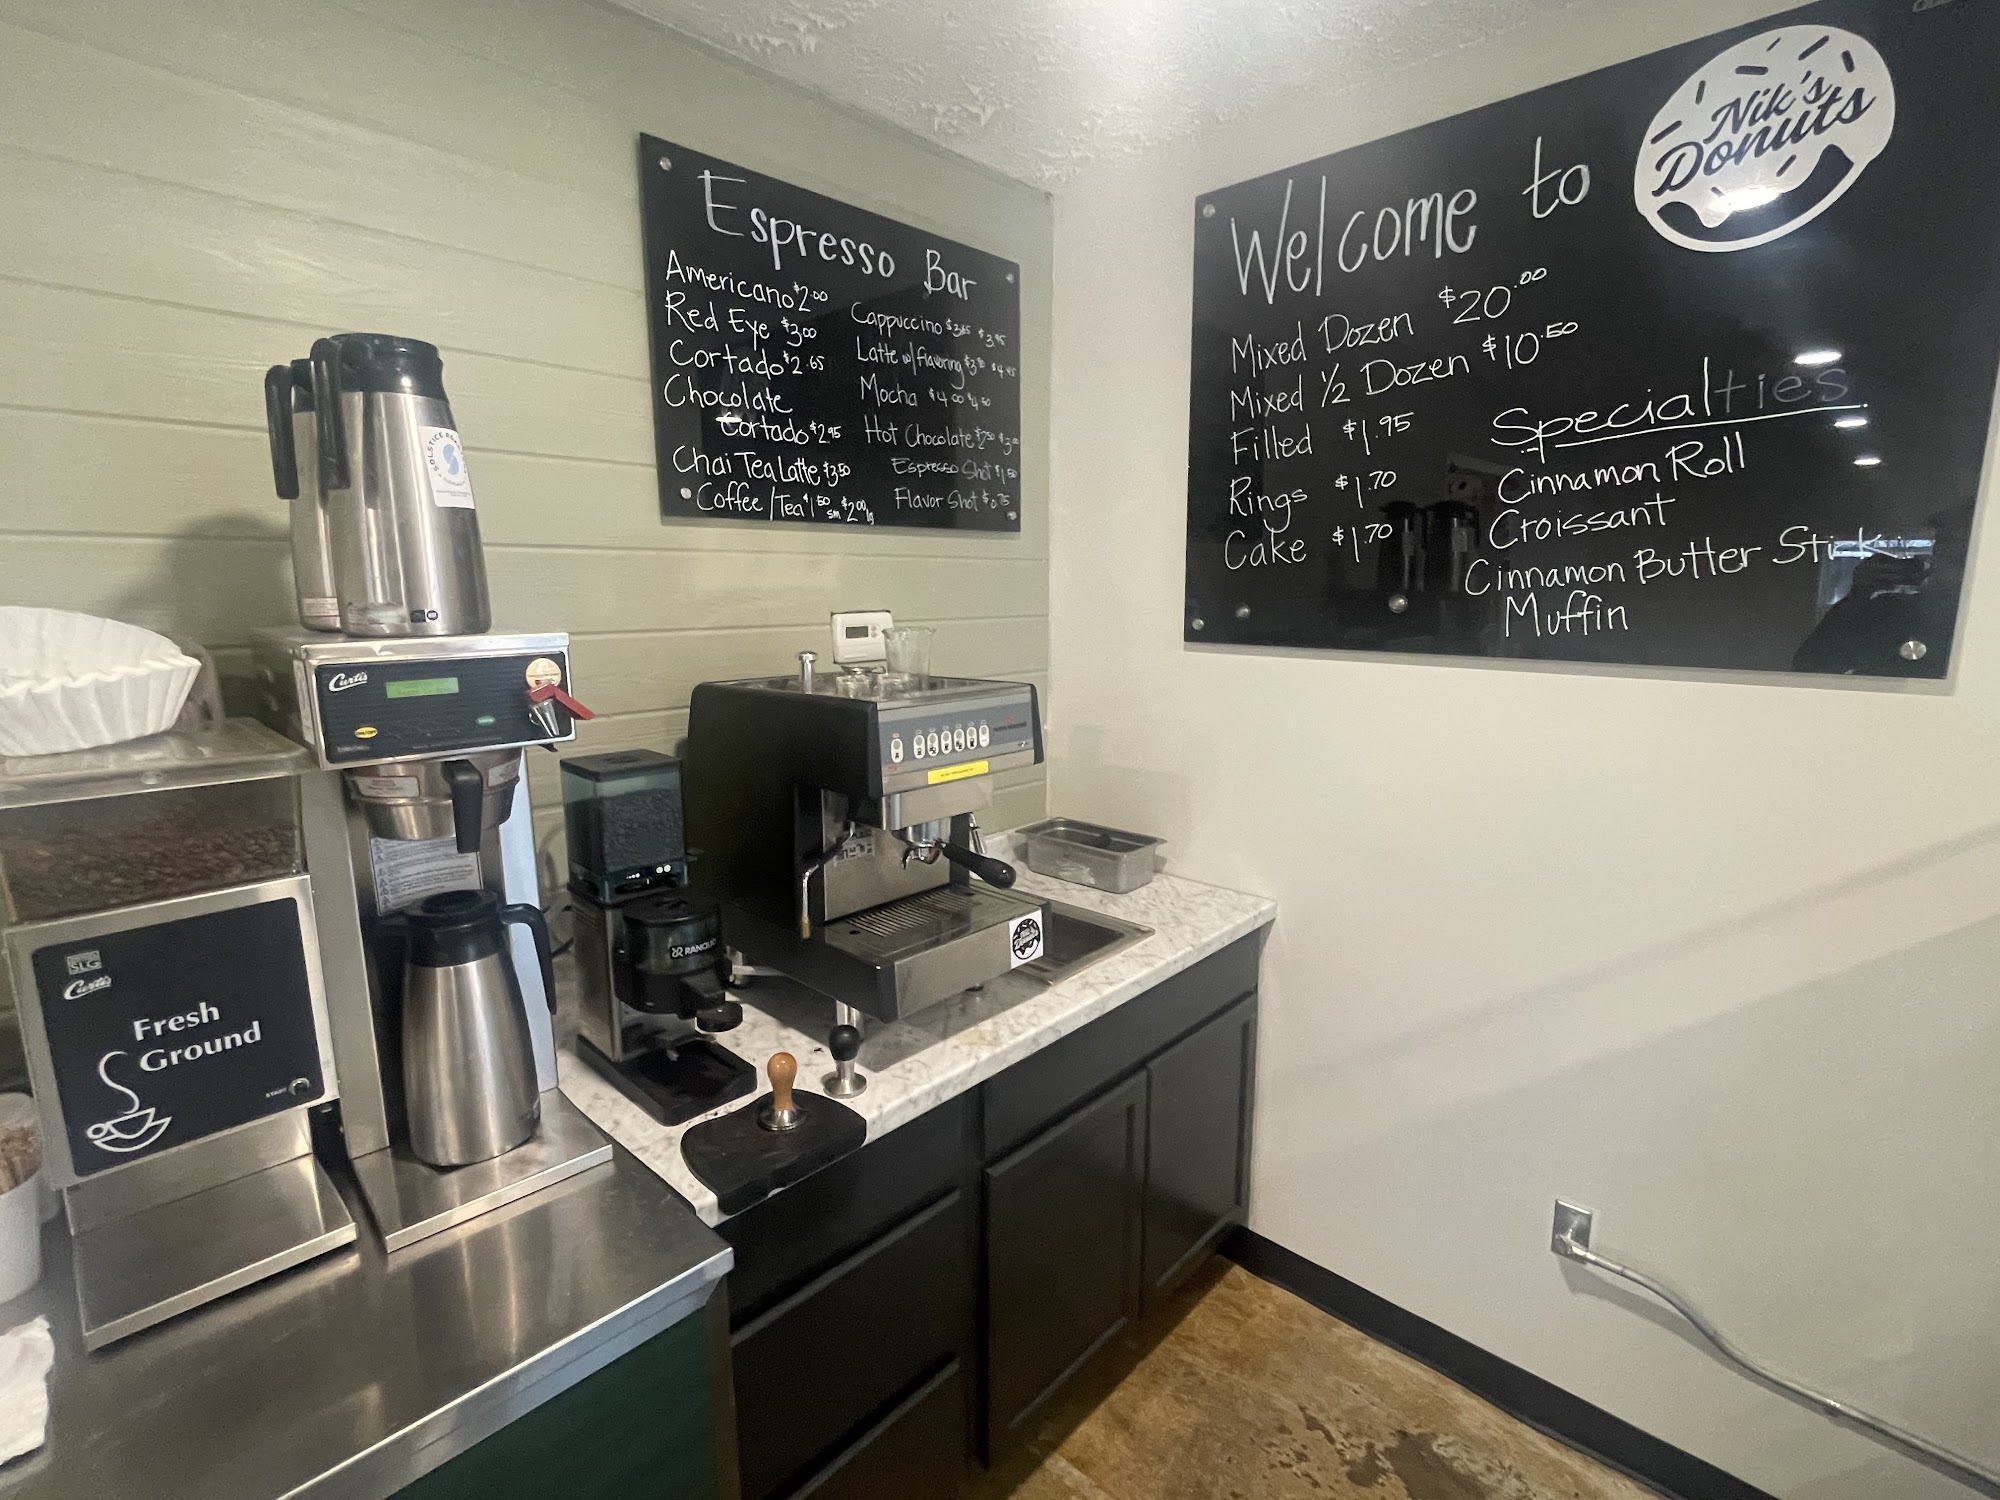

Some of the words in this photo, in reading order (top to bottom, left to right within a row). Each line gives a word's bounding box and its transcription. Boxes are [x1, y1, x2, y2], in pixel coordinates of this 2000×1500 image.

[1703, 70, 1835, 145] Nik's
[1651, 86, 1878, 198] Donuts
[697, 169, 896, 278] Espresso
[923, 248, 978, 301] Bar
[1230, 175, 1477, 305] Welcome
[1521, 136, 1591, 219] to
[665, 249, 795, 309] Americano
[793, 281, 829, 313] $2.00
[665, 289, 720, 333] Red
[728, 308, 770, 351] Eye
[851, 301, 943, 338] Cappuccino
[1231, 321, 1307, 378] Mixed
[1317, 311, 1414, 354] Dozen
[1438, 267, 1547, 324] $20.00
[669, 339, 785, 380] Cortado
[783, 350, 825, 375] $2.65
[856, 335, 898, 364] Latte
[1230, 374, 1303, 421] Mixed
[1360, 353, 1470, 396] Dozen
[1481, 321, 1579, 369] $10.50
[664, 373, 793, 414] Chocolate
[860, 372, 918, 407] Mocha
[1490, 356, 1849, 464] Specialties
[427, 431, 444, 472] SOLSTICE
[720, 411, 810, 445] Cortado
[809, 420, 842, 444] $2.95
[864, 414, 898, 446] Hot
[904, 423, 975, 449] Chocolate
[1230, 423, 1313, 465] Filled
[1342, 411, 1415, 455] $1.95
[672, 445, 732, 476] Chai
[734, 451, 778, 482] Tea
[778, 455, 821, 486] Latte
[890, 457, 960, 478] Espresso
[961, 459, 992, 480] Shot
[1497, 460, 1657, 504] Cinnamon
[1665, 431, 1744, 482] Roll
[696, 481, 764, 512] Coffee
[826, 508, 842, 520] sm
[893, 486, 944, 509] Flavor
[947, 489, 979, 512] Shot
[1229, 475, 1308, 534] Rings
[1334, 470, 1397, 508] $1.70
[1489, 492, 1676, 549] Croissant
[1223, 527, 1307, 570] Cake
[1331, 522, 1393, 562] $1.70
[1464, 557, 1626, 596] Cinnamon
[1634, 535, 1762, 585] Butter
[1504, 589, 1629, 638] Muffin
[328, 671, 368, 692] Curtis
[133, 1002, 220, 1041] Fresh
[139, 1021, 262, 1072] Ground
